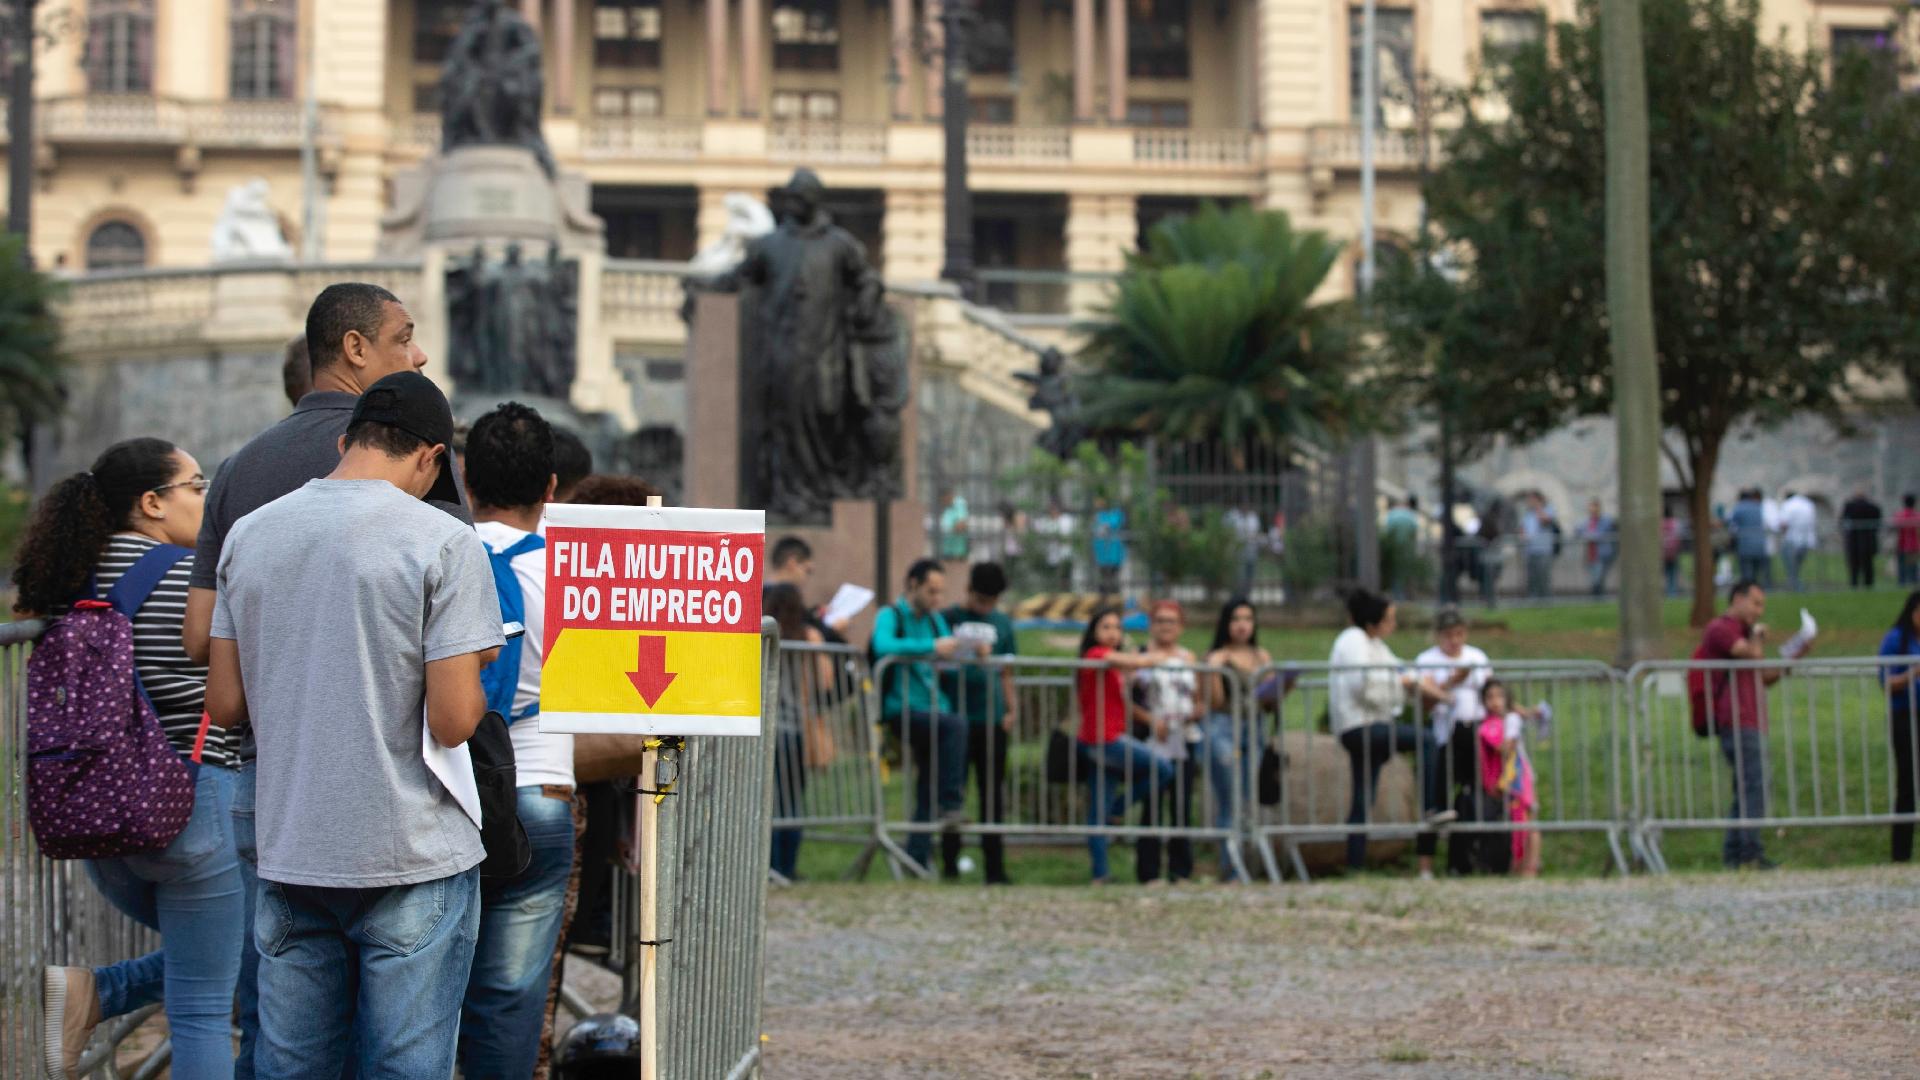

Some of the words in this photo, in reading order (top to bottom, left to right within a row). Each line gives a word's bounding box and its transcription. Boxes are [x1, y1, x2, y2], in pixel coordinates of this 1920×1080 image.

[554, 542, 615, 578] FILA
[625, 539, 754, 582] MUTIRÃO
[563, 586, 600, 621] DO
[611, 587, 742, 624] EMPREGO
